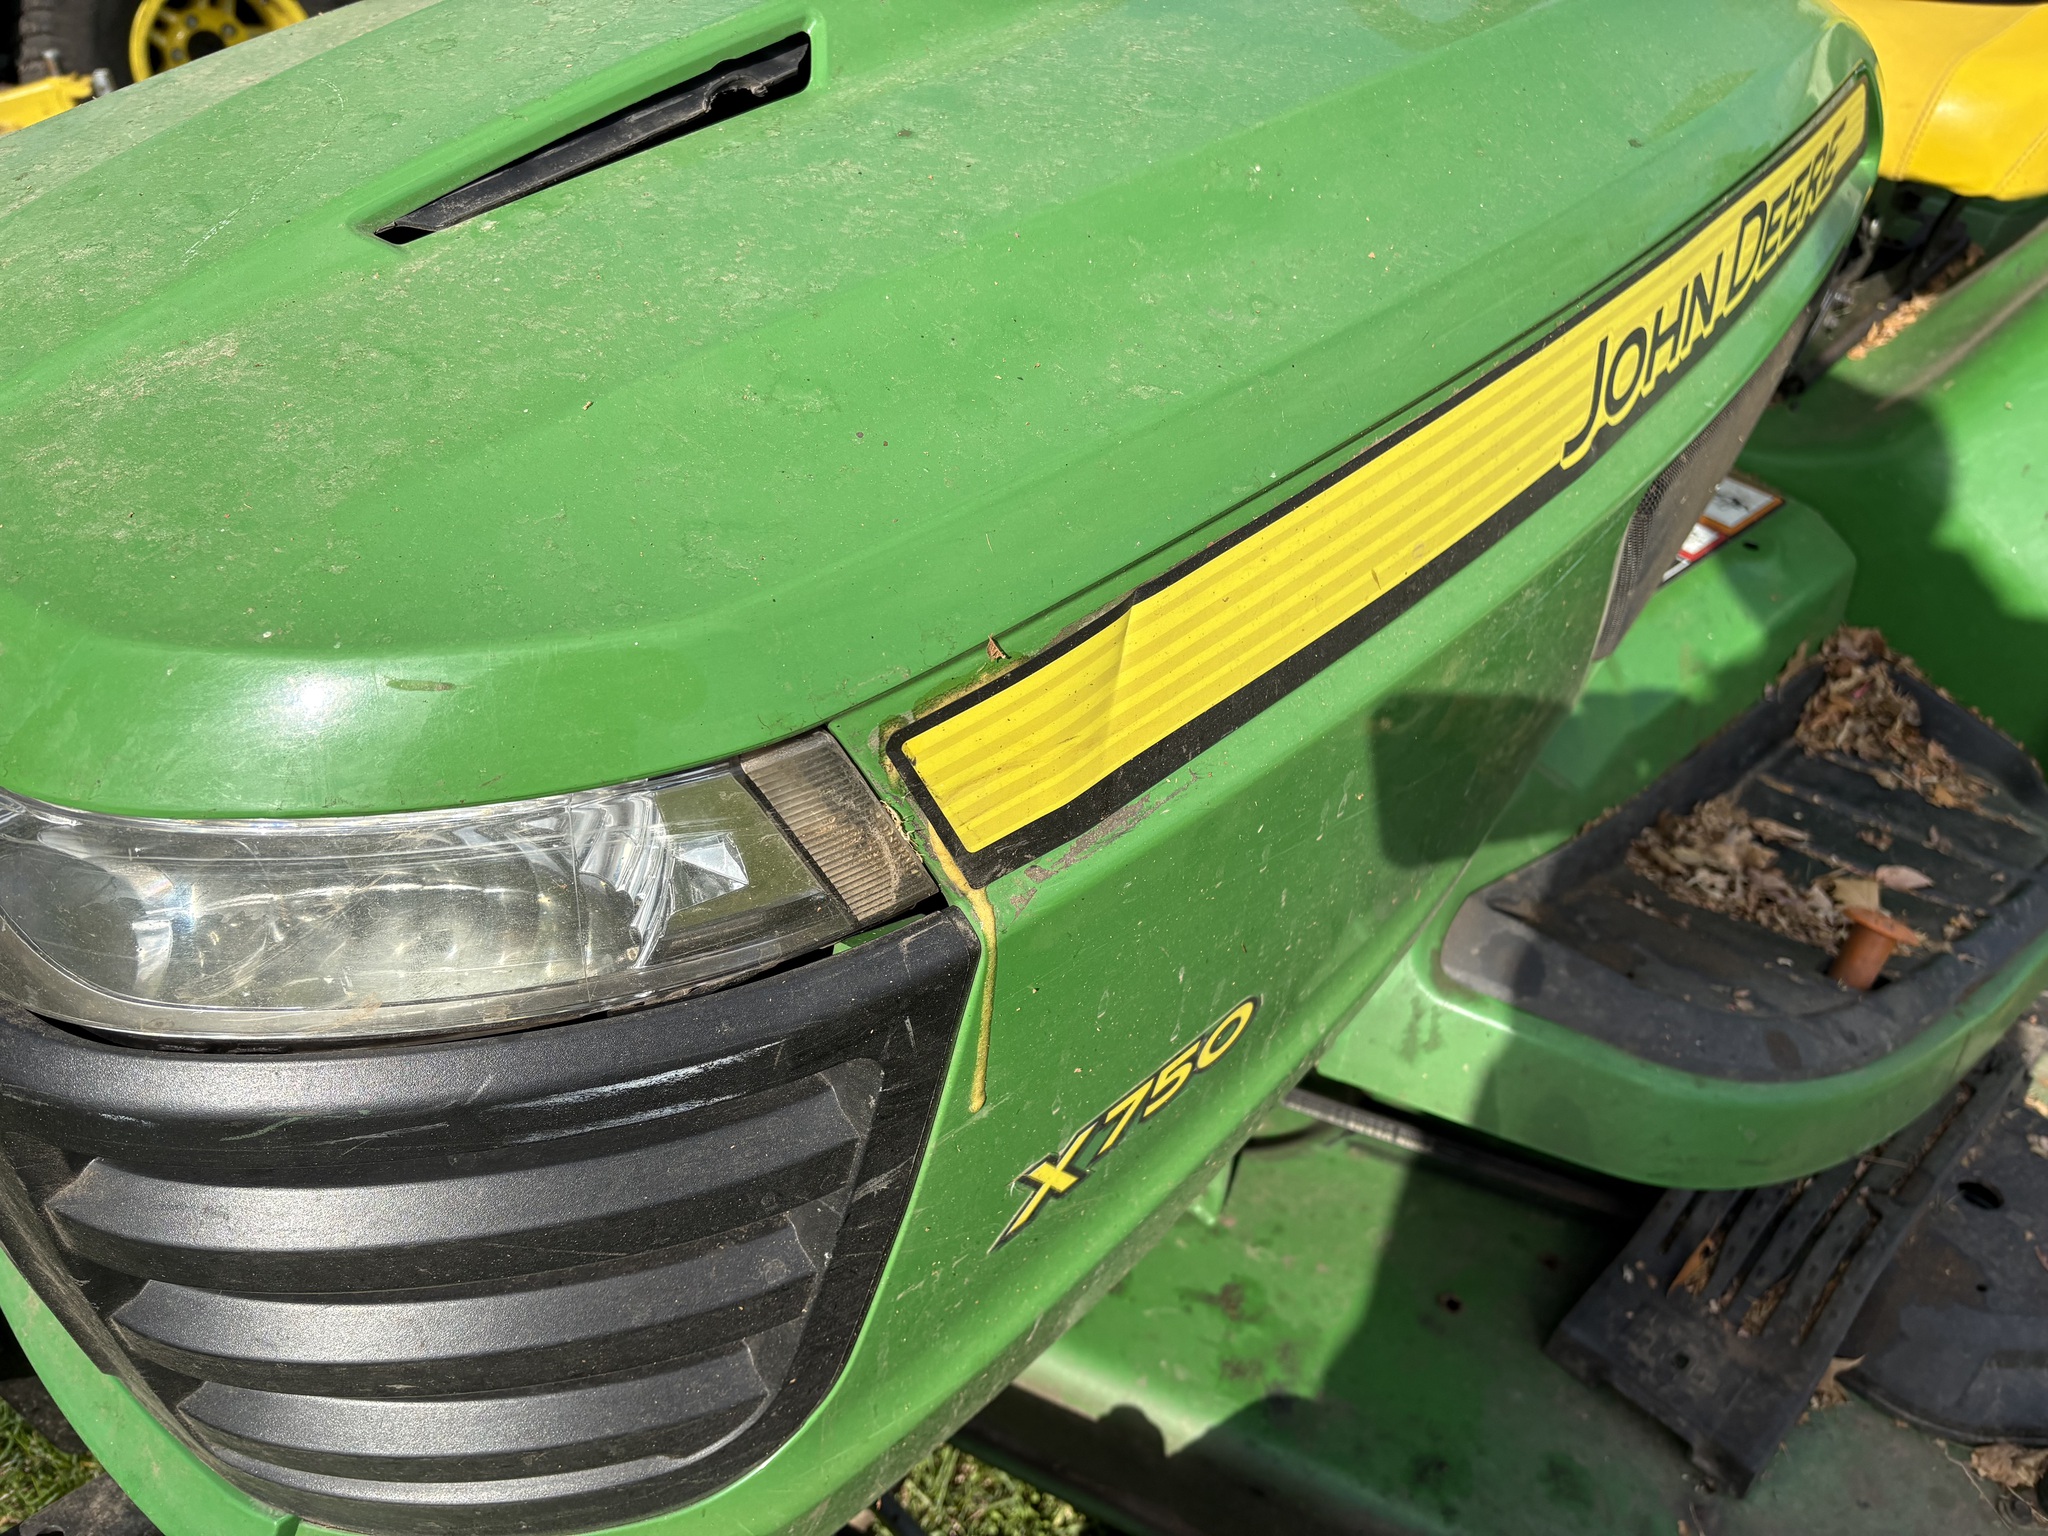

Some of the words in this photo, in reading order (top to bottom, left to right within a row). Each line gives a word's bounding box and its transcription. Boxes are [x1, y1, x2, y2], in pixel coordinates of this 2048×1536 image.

[1562, 250, 1725, 462] JOHN
[1726, 116, 1848, 312] DEERE
[998, 998, 1258, 1242] X750
